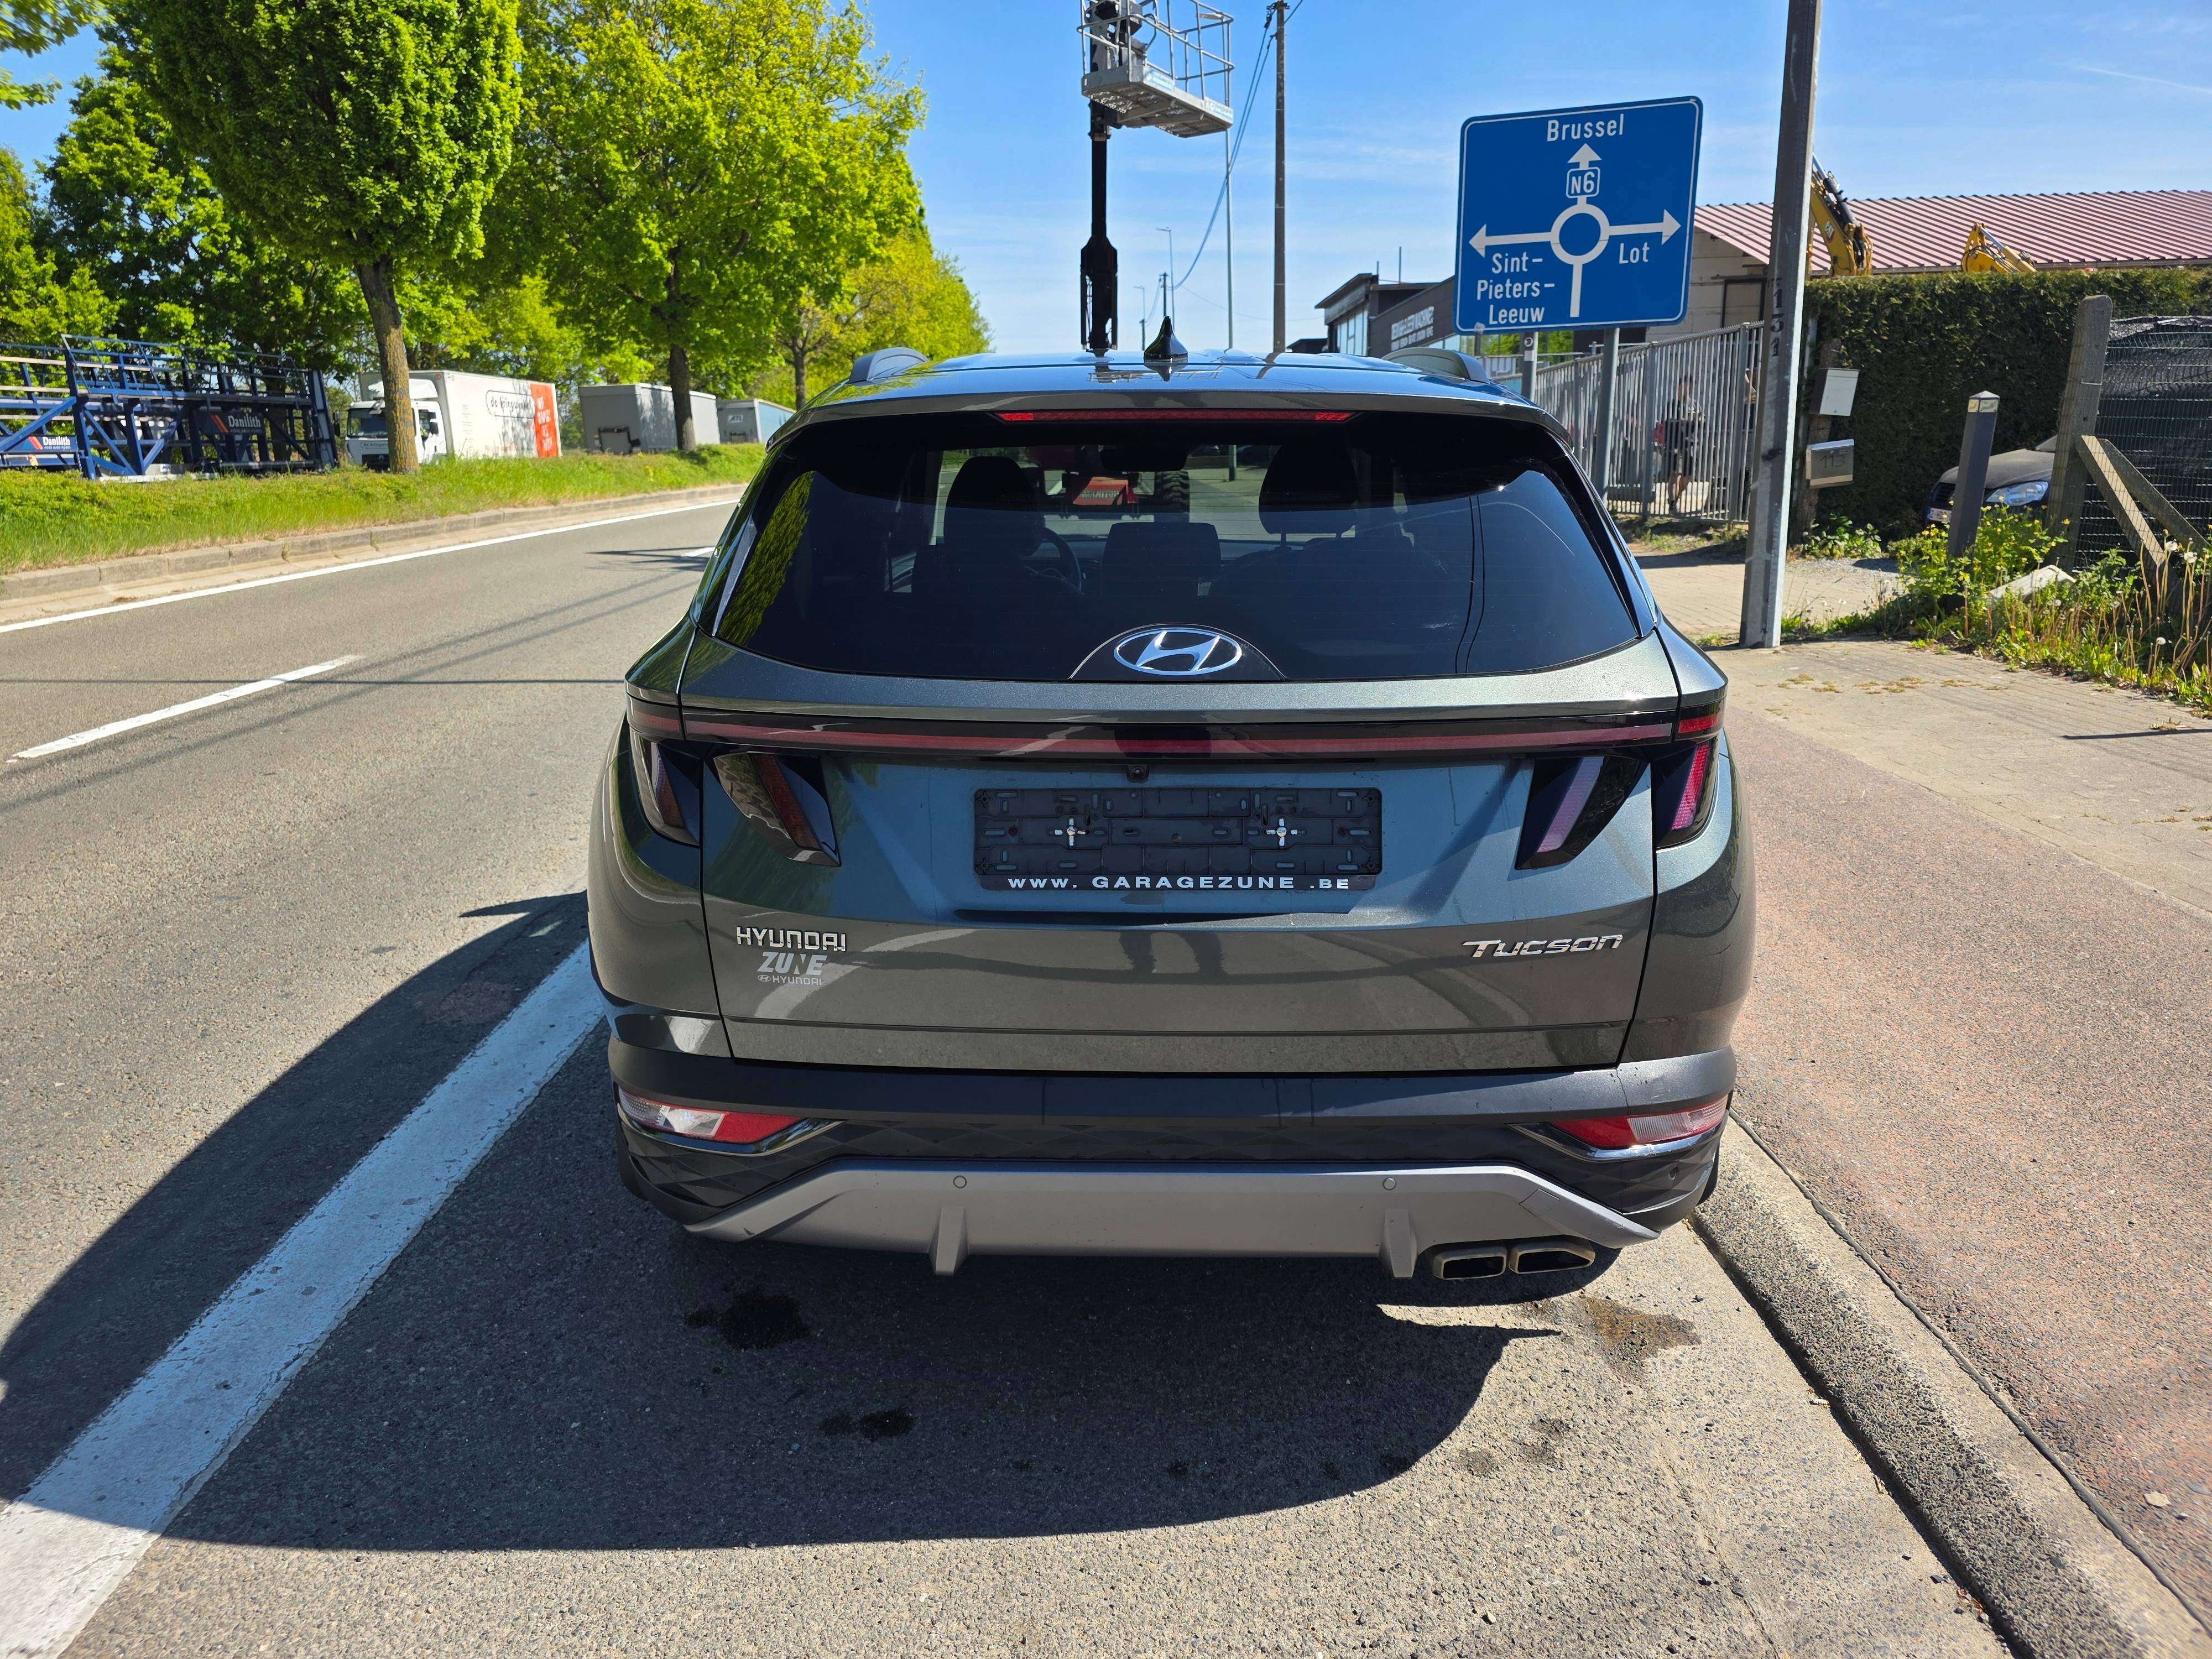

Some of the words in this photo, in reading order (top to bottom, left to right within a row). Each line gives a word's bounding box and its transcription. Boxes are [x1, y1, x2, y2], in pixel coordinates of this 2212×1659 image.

[1547, 113, 1624, 142] Brussel
[1571, 171, 1595, 194] N6
[1491, 252, 1543, 274] Sint-
[1619, 242, 1650, 264] Lot
[1477, 279, 1555, 300] Pieters-
[1489, 305, 1545, 325] Leeuw
[227, 414, 261, 427] Danilith
[43, 436, 71, 446] Danilith
[1092, 877, 1293, 889] GARAGEZUNE
[1310, 879, 1348, 889] .BE
[736, 927, 846, 952] HYUNDAI
[1462, 935, 1623, 958] TUCSON
[757, 951, 827, 975] ZUNE
[773, 975, 823, 985] HYUNDAI
